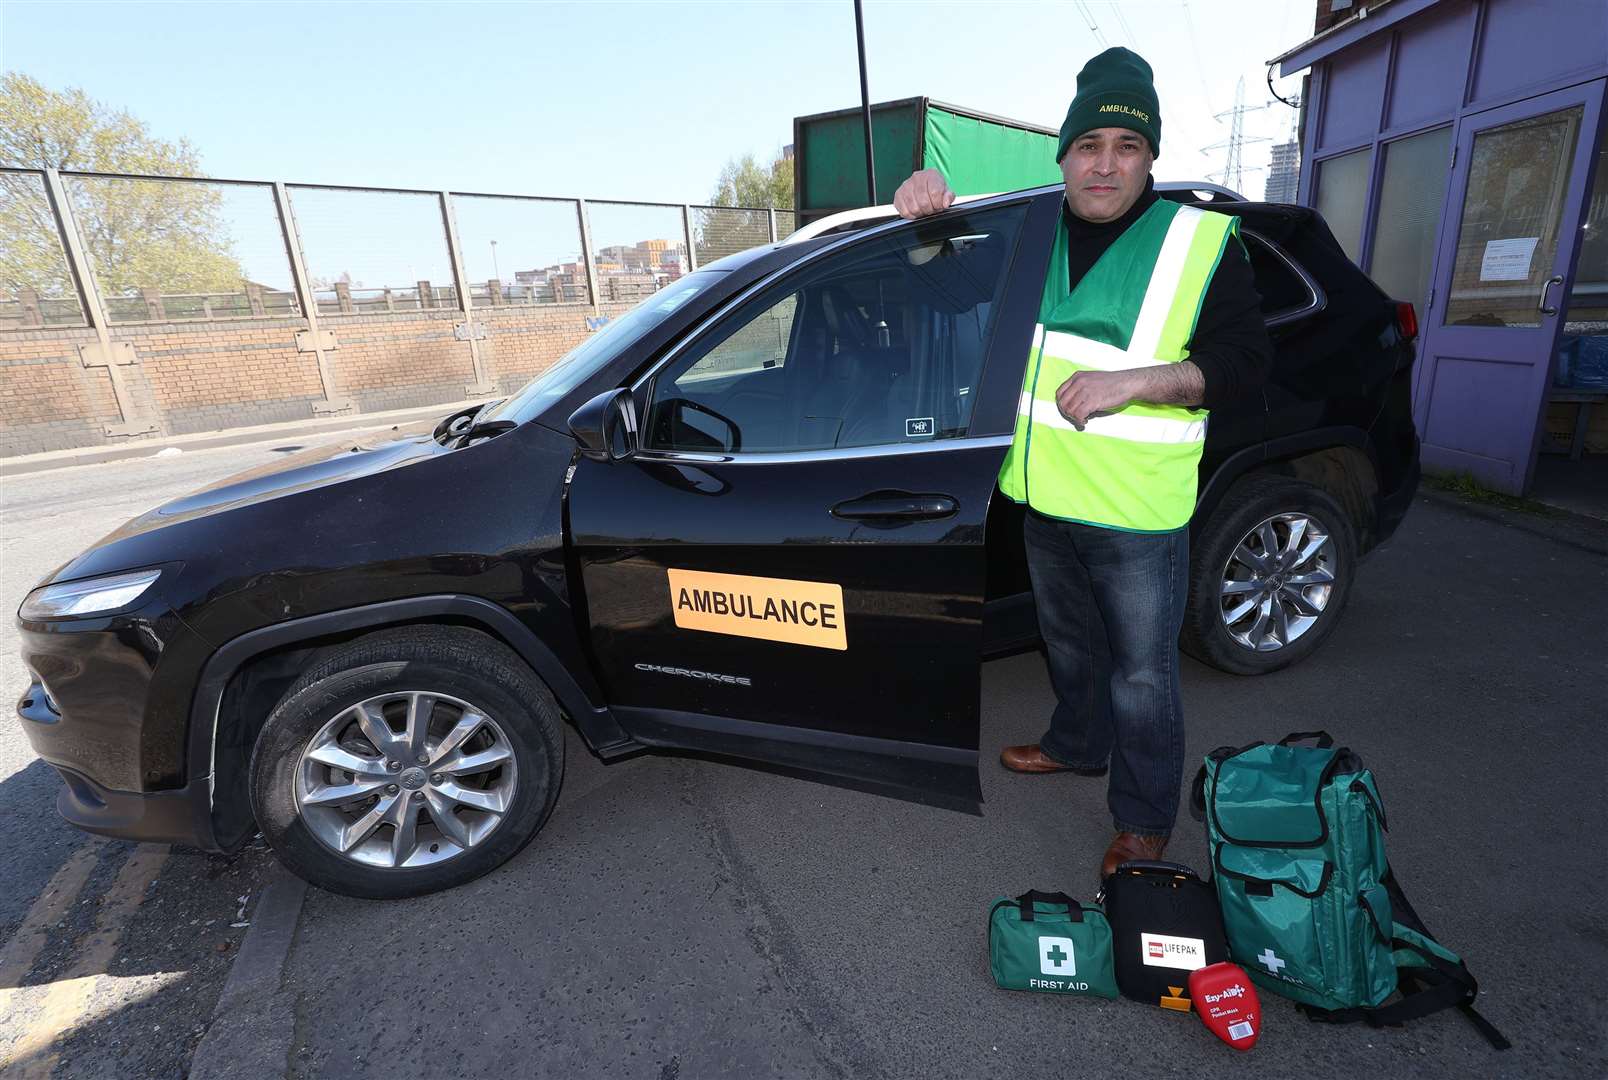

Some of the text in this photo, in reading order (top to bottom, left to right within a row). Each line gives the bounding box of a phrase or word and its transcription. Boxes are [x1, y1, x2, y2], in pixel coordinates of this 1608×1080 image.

[1099, 104, 1149, 123] AMBULANCE
[677, 587, 838, 629] AMBULANCE
[634, 663, 752, 686] CHEROKEE
[1164, 943, 1197, 955] LIFEPAK
[1030, 978, 1089, 991] FIRST AID
